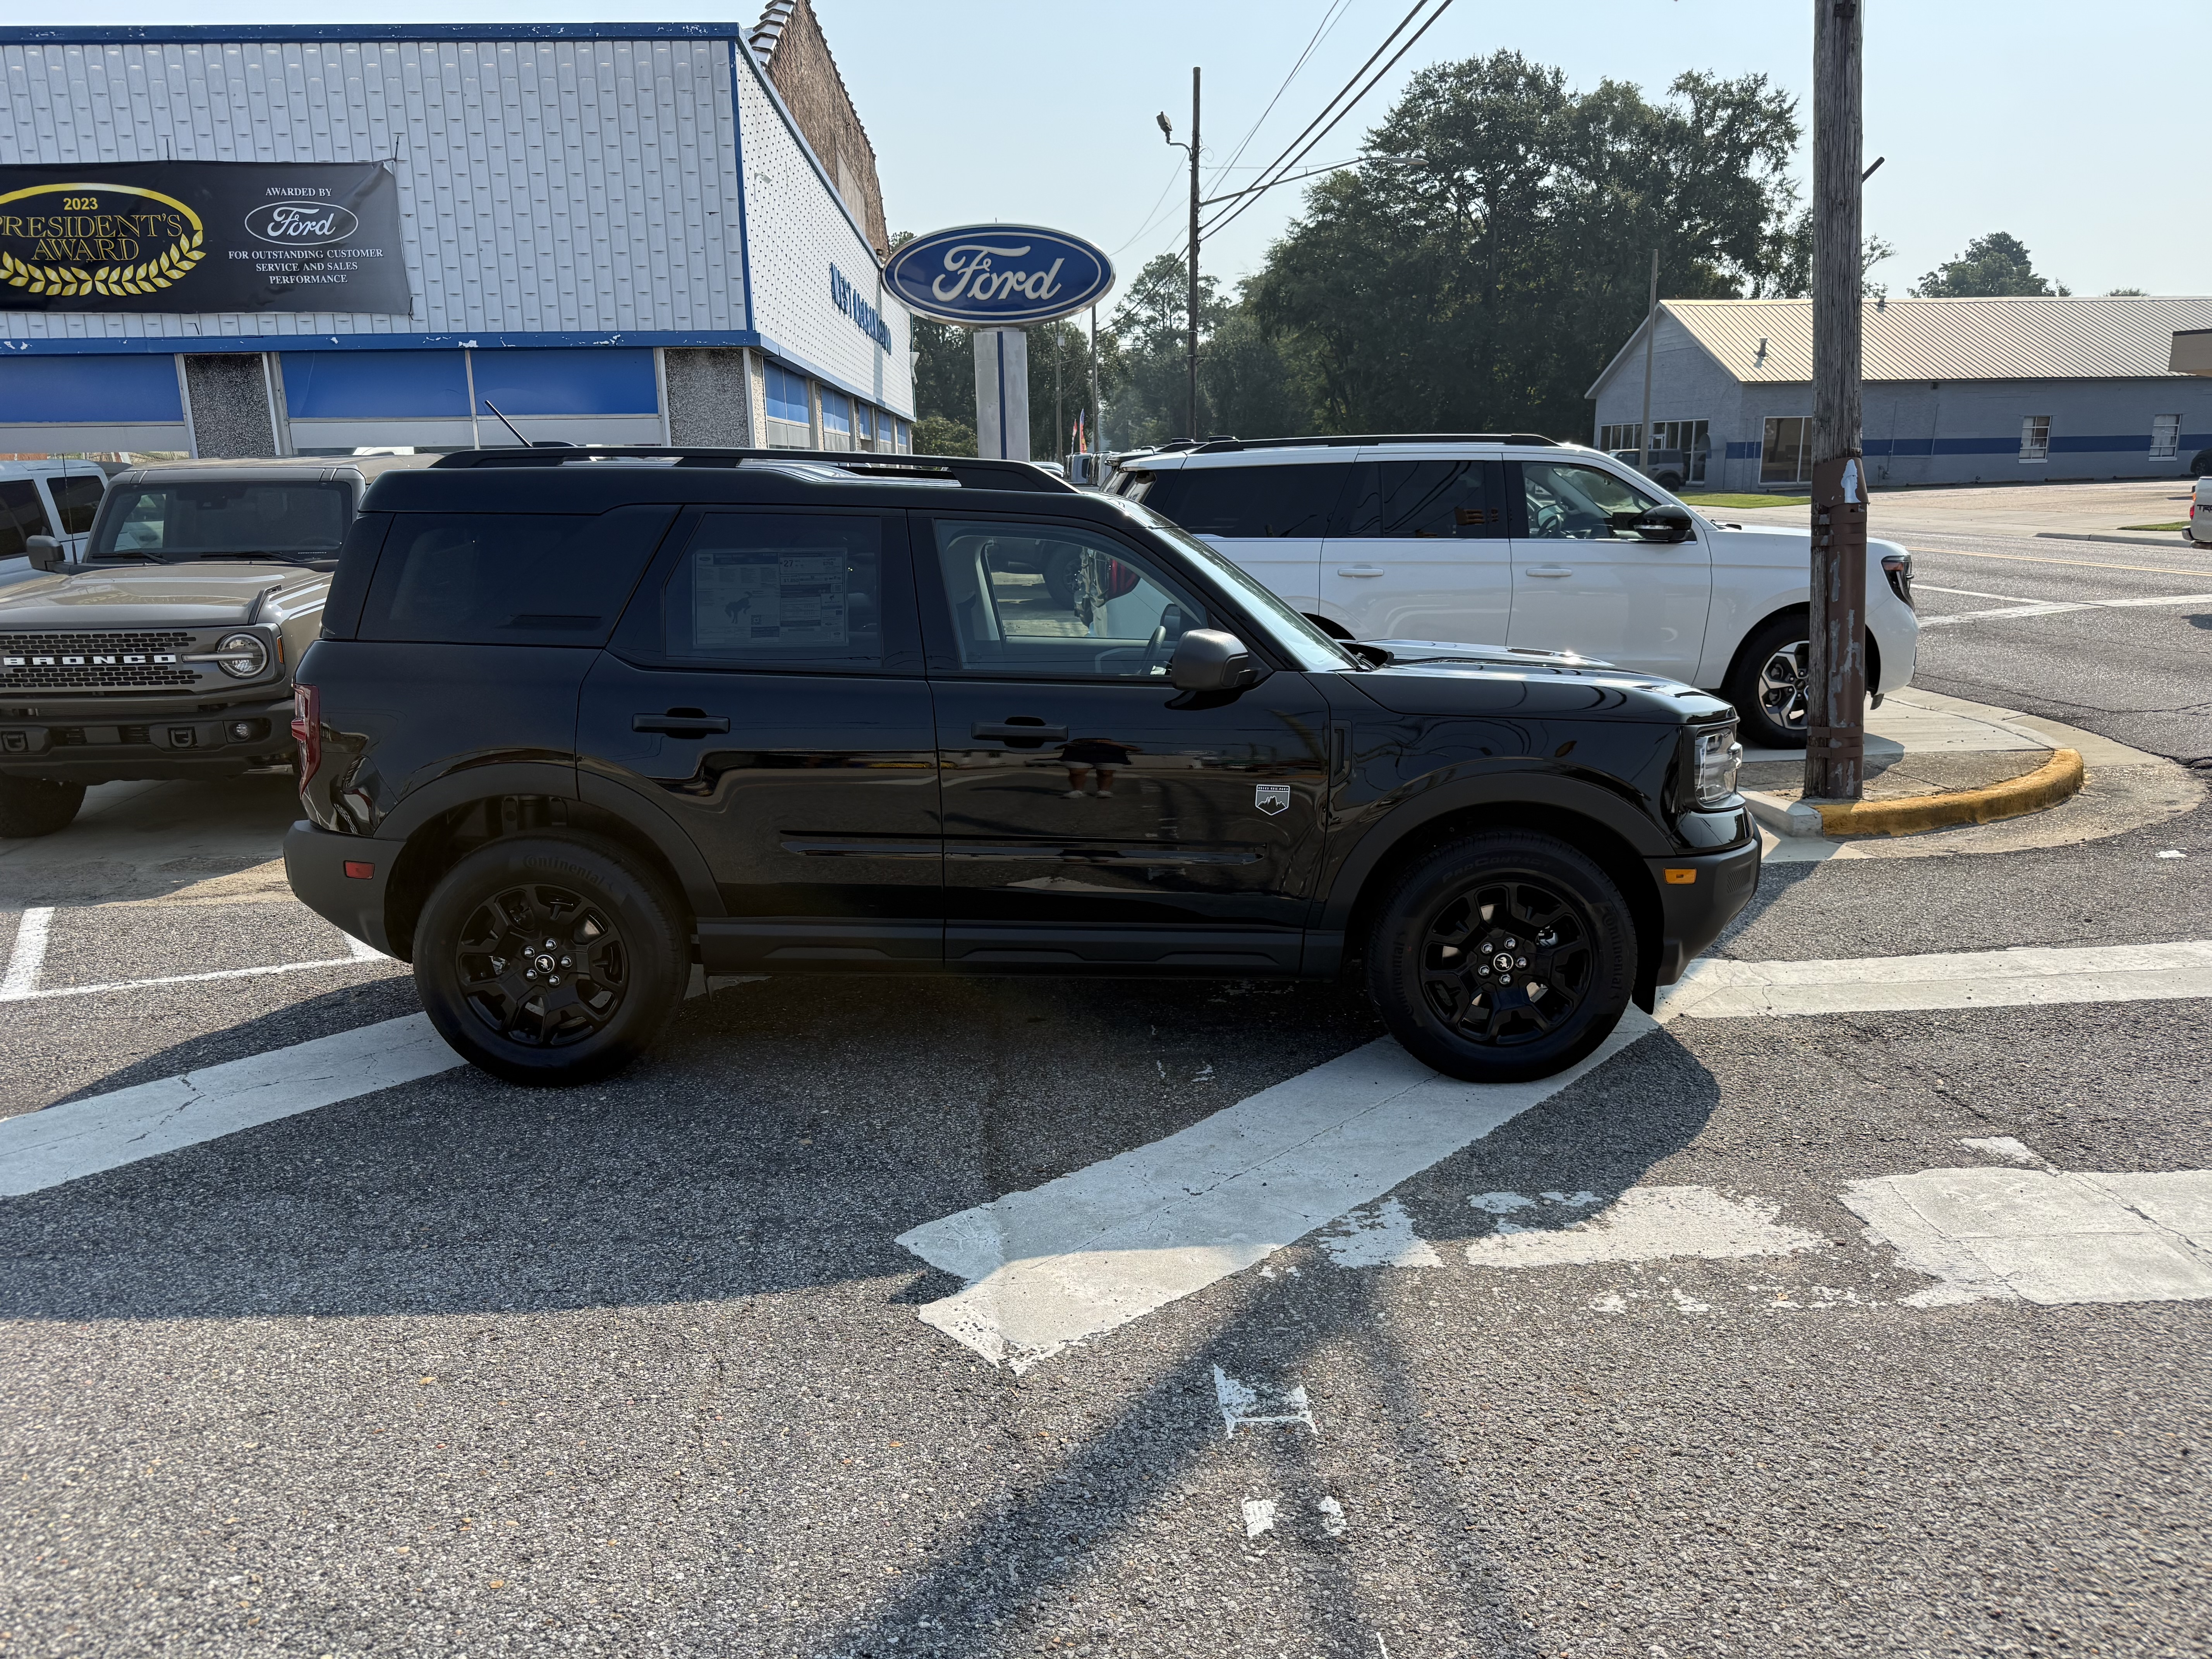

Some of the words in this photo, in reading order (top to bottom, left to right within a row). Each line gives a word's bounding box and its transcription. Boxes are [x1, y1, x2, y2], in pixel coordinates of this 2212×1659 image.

[266, 187, 316, 196] AWARDED
[319, 188, 332, 196] BY
[63, 198, 98, 210] 2023
[0, 213, 182, 238] RESIDENT'S
[267, 207, 336, 236] Ford
[31, 239, 139, 261] AWARD
[228, 251, 249, 259] FOR
[252, 250, 324, 259] OUTSTANDING
[327, 249, 384, 258] CUSTOMER
[256, 263, 299, 271] SERVICE
[303, 263, 325, 271] AND
[327, 262, 358, 270] SALES
[932, 245, 1065, 302] Ford
[270, 275, 348, 284] PERFORMANCE
[2197, 504, 2212, 512] TR
[4, 655, 177, 665] BRONCO
[523, 854, 605, 886] Continental
